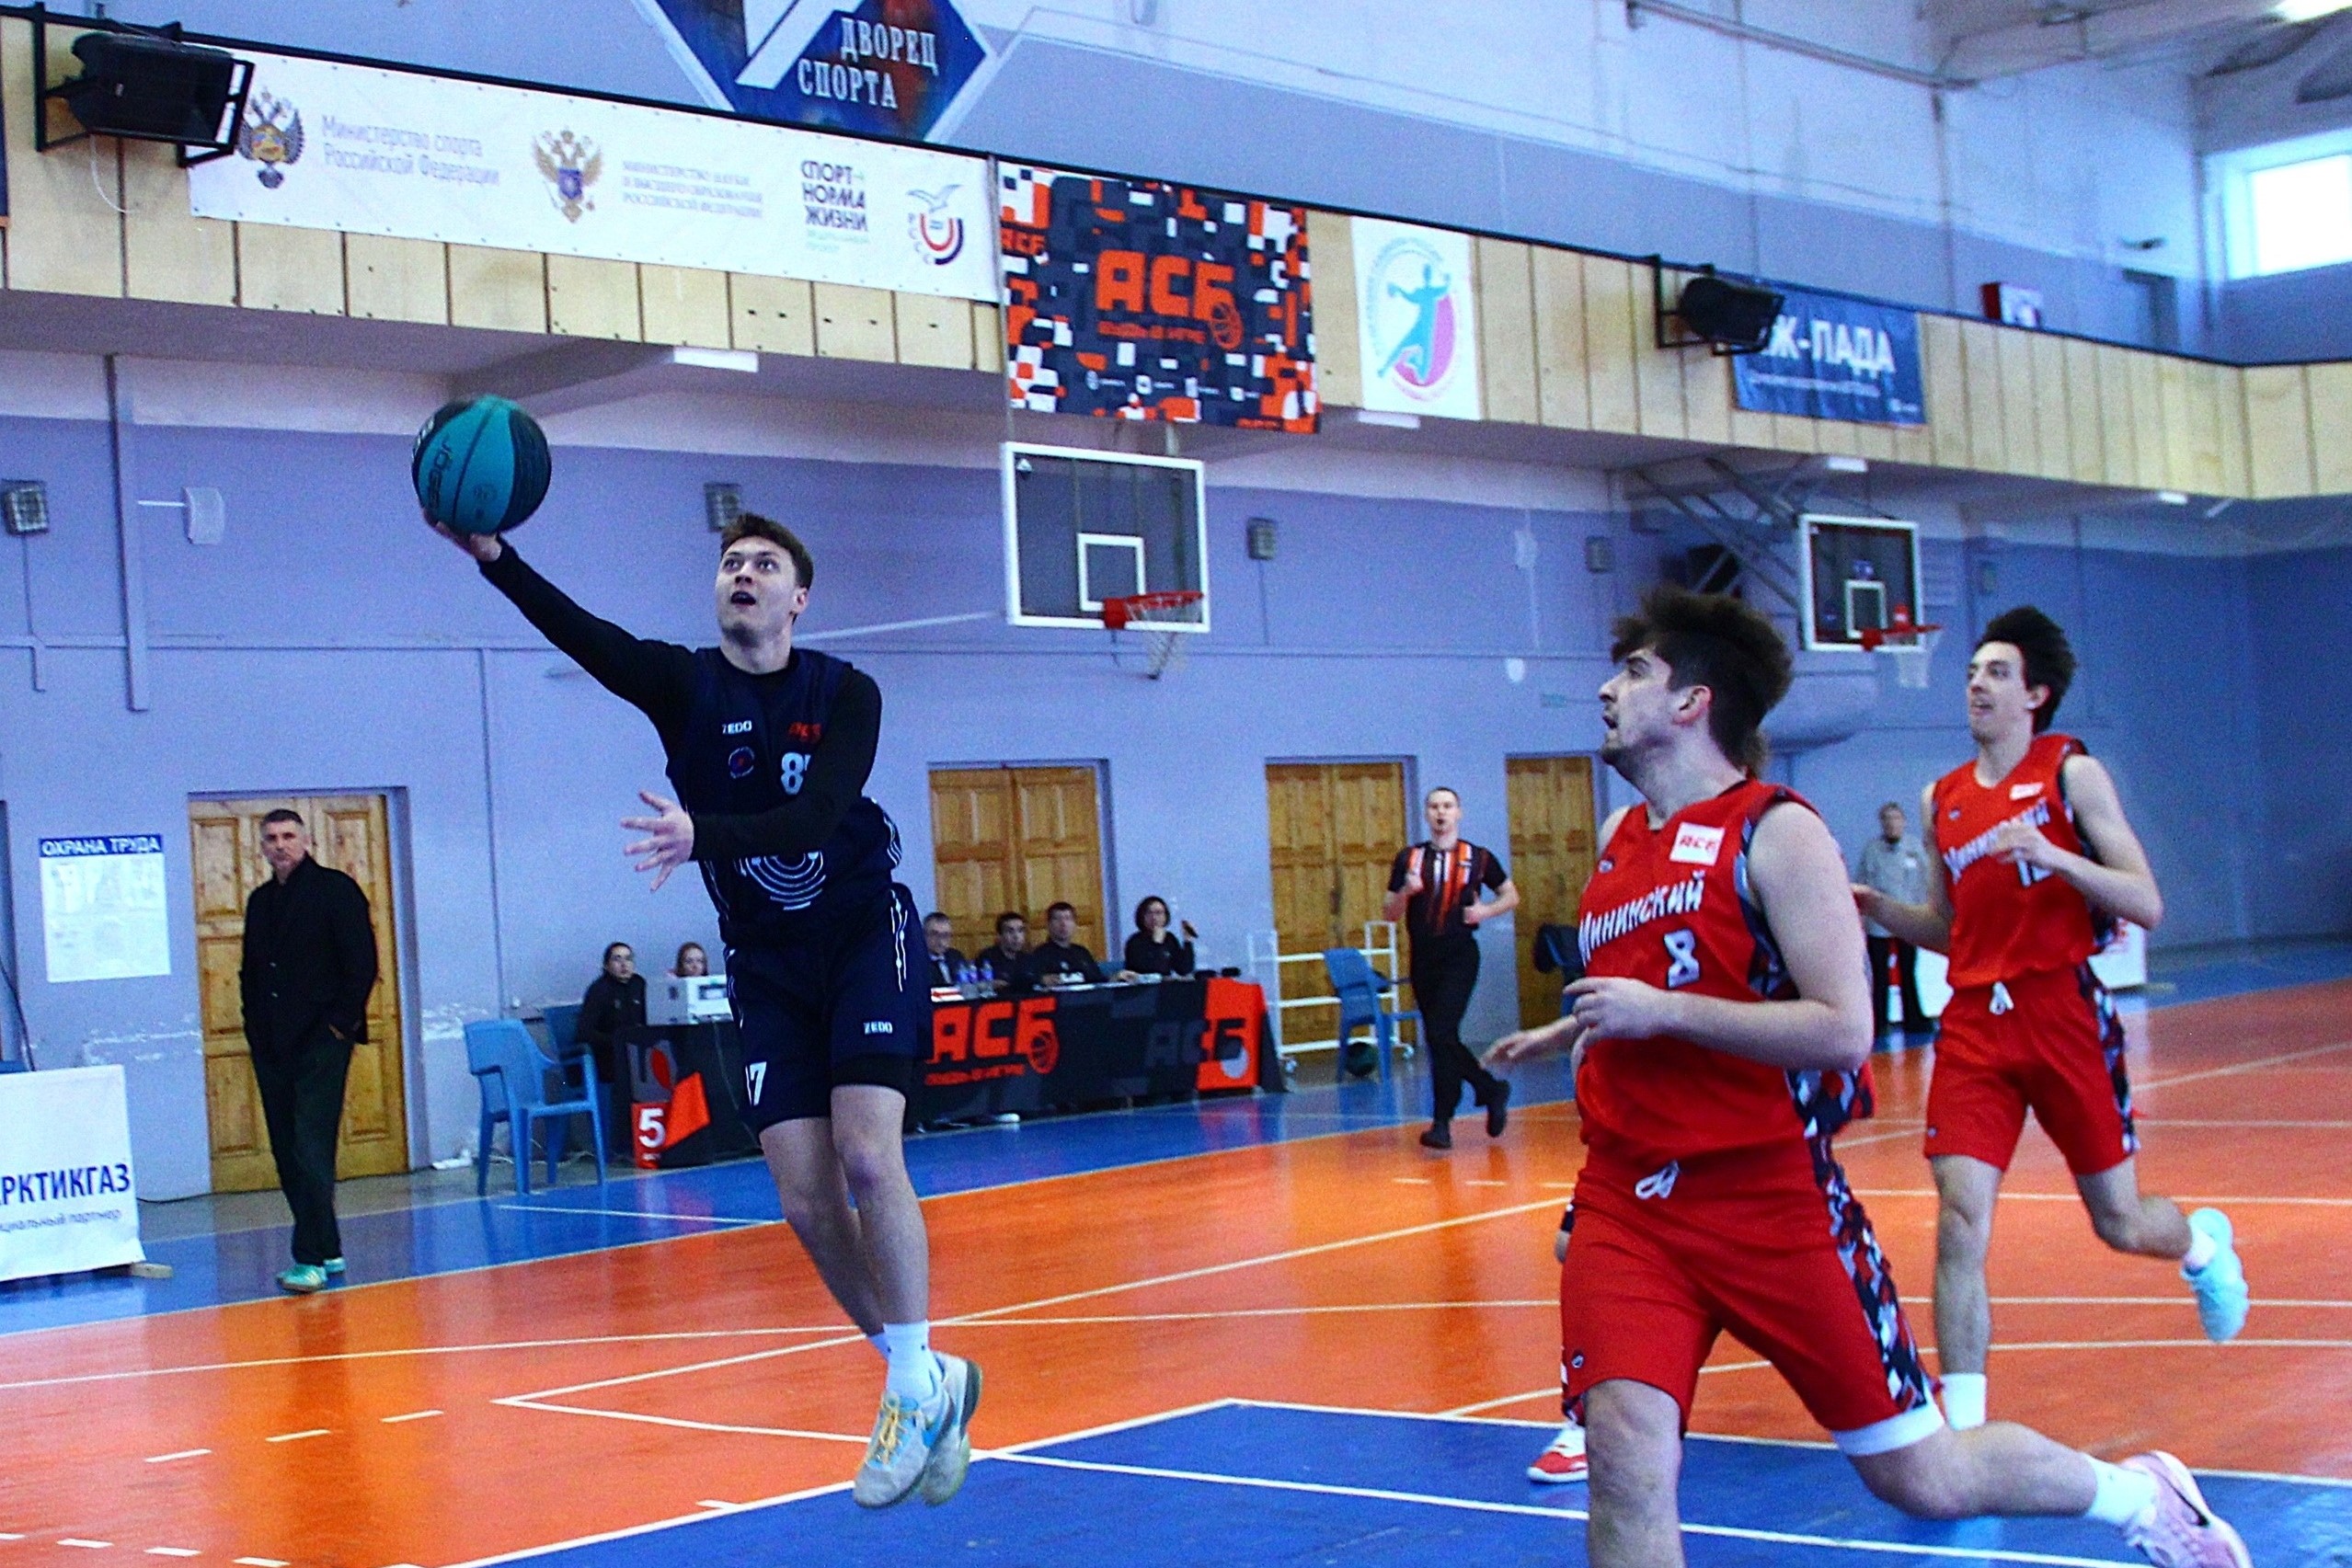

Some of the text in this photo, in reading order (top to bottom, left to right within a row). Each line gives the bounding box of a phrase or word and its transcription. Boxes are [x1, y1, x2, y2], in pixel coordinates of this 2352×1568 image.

[840, 17, 939, 76] ДВОРЕЦ
[797, 58, 899, 109] СПОРТА
[802, 182, 866, 210] НОРМА
[805, 204, 868, 232] ЖИЗНИ
[780, 751, 811, 795] 8
[41, 836, 161, 856] ОХРАНА ТРУДА
[1663, 928, 1700, 989] 8
[863, 1021, 894, 1036] ZEDO
[744, 1060, 767, 1106] 7
[638, 1107, 666, 1149] 5
[0, 1163, 131, 1206] РКТИКГАЗ
